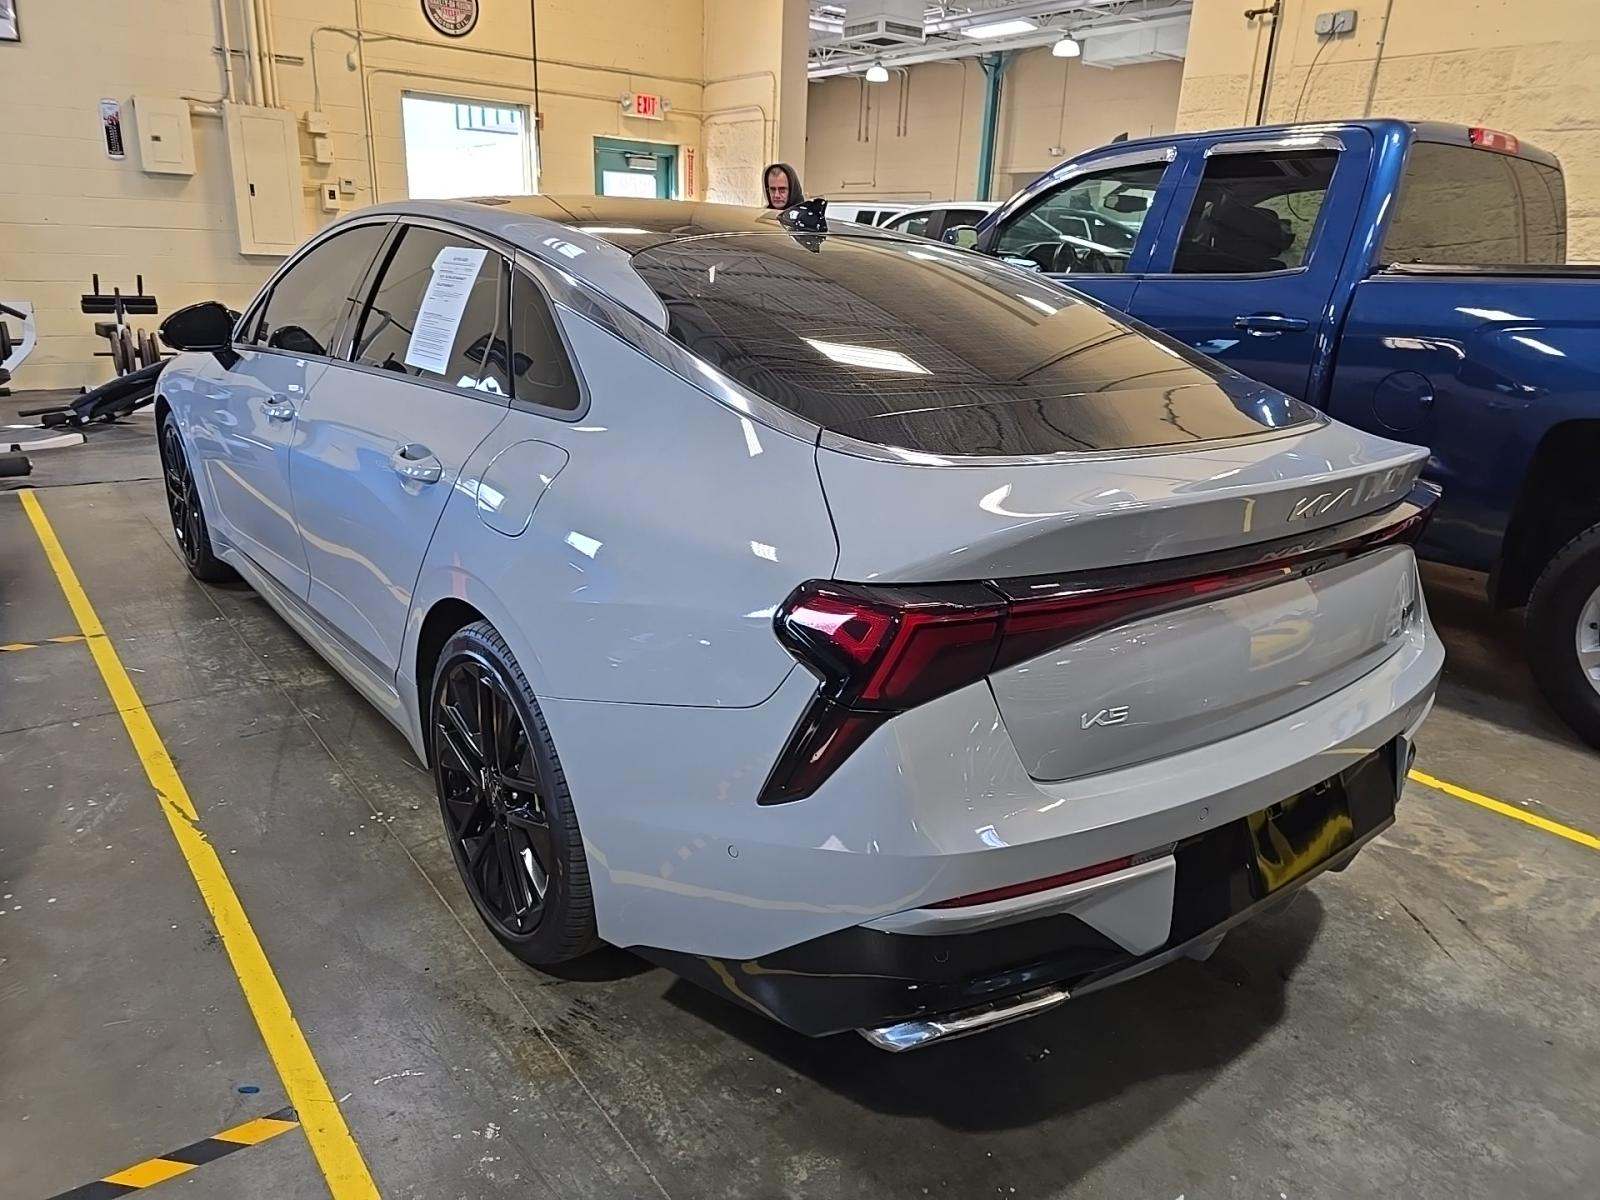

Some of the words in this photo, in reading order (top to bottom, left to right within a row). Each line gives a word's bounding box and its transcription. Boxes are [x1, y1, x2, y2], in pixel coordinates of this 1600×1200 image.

[456, 18, 470, 30] OIL
[637, 95, 656, 115] EXIT
[1080, 705, 1129, 729] K5
